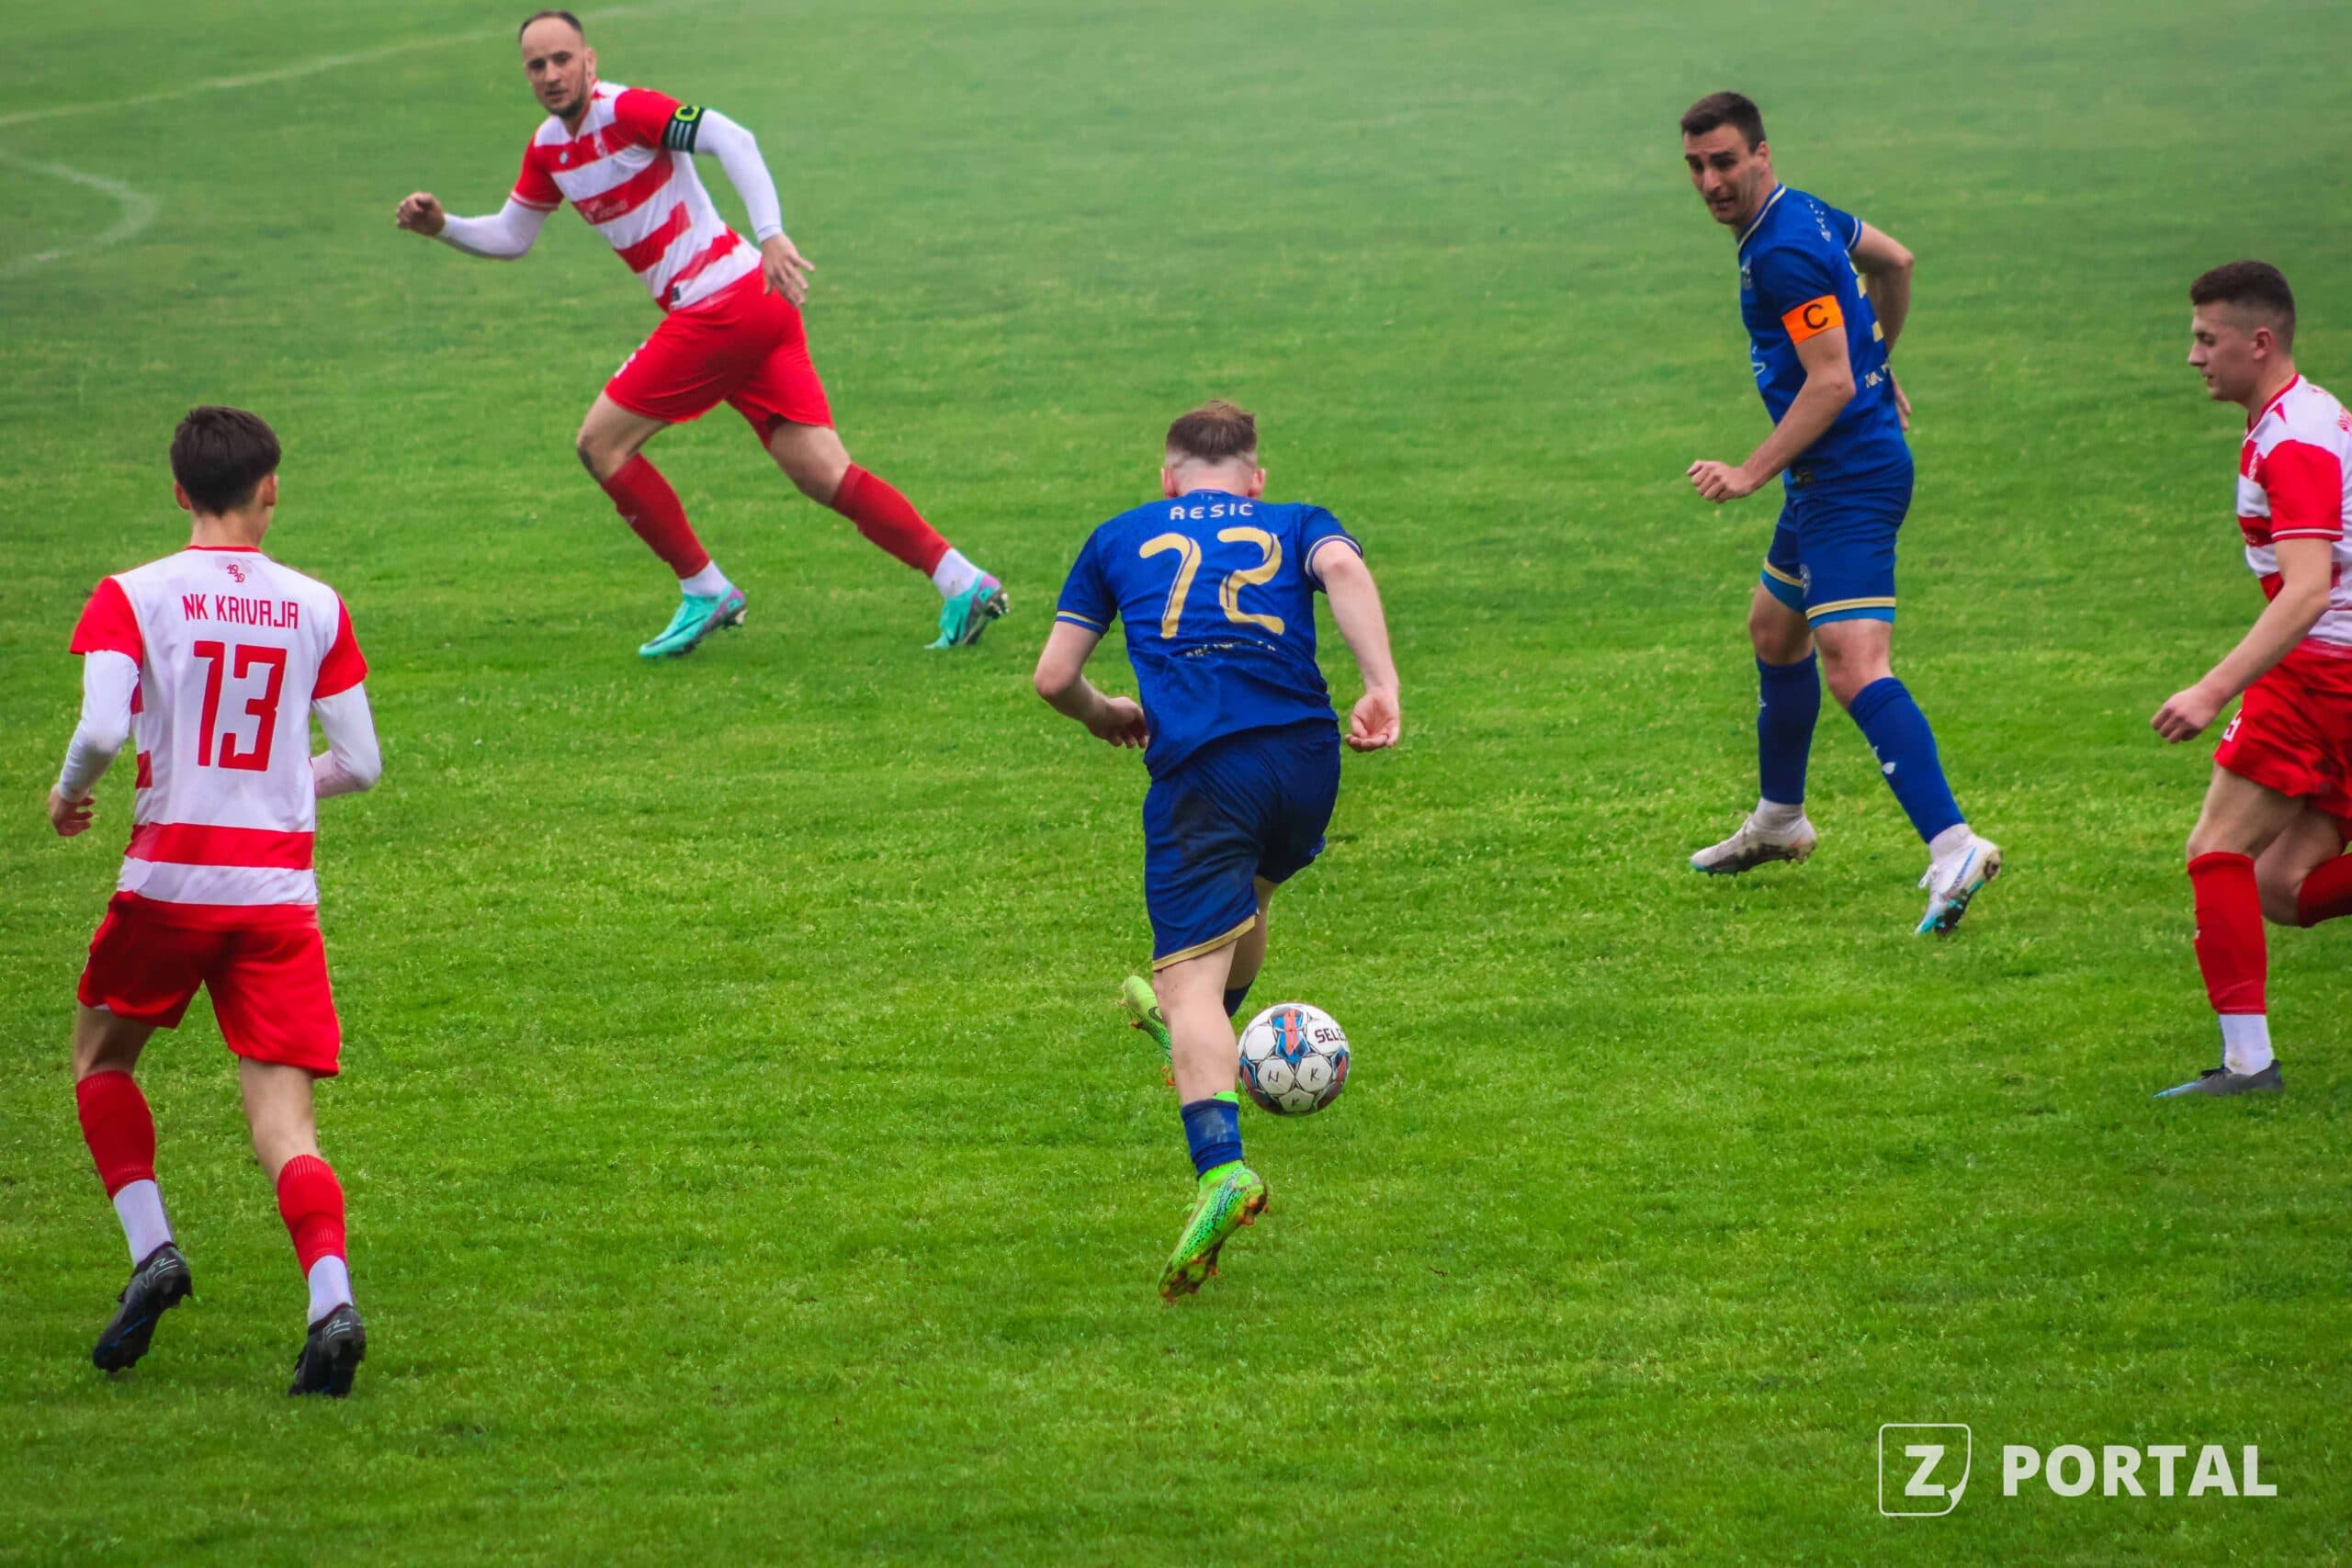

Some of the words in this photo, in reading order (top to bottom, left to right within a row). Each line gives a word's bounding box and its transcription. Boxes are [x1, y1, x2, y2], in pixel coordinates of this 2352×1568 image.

[675, 105, 700, 121] C
[1803, 303, 1828, 330] C
[1138, 525, 1285, 639] 72
[182, 594, 209, 621] NK
[215, 595, 299, 629] KRIVAJA
[193, 640, 288, 772] 13
[1268, 1070, 1279, 1082] N
[1310, 1067, 1320, 1081] K
